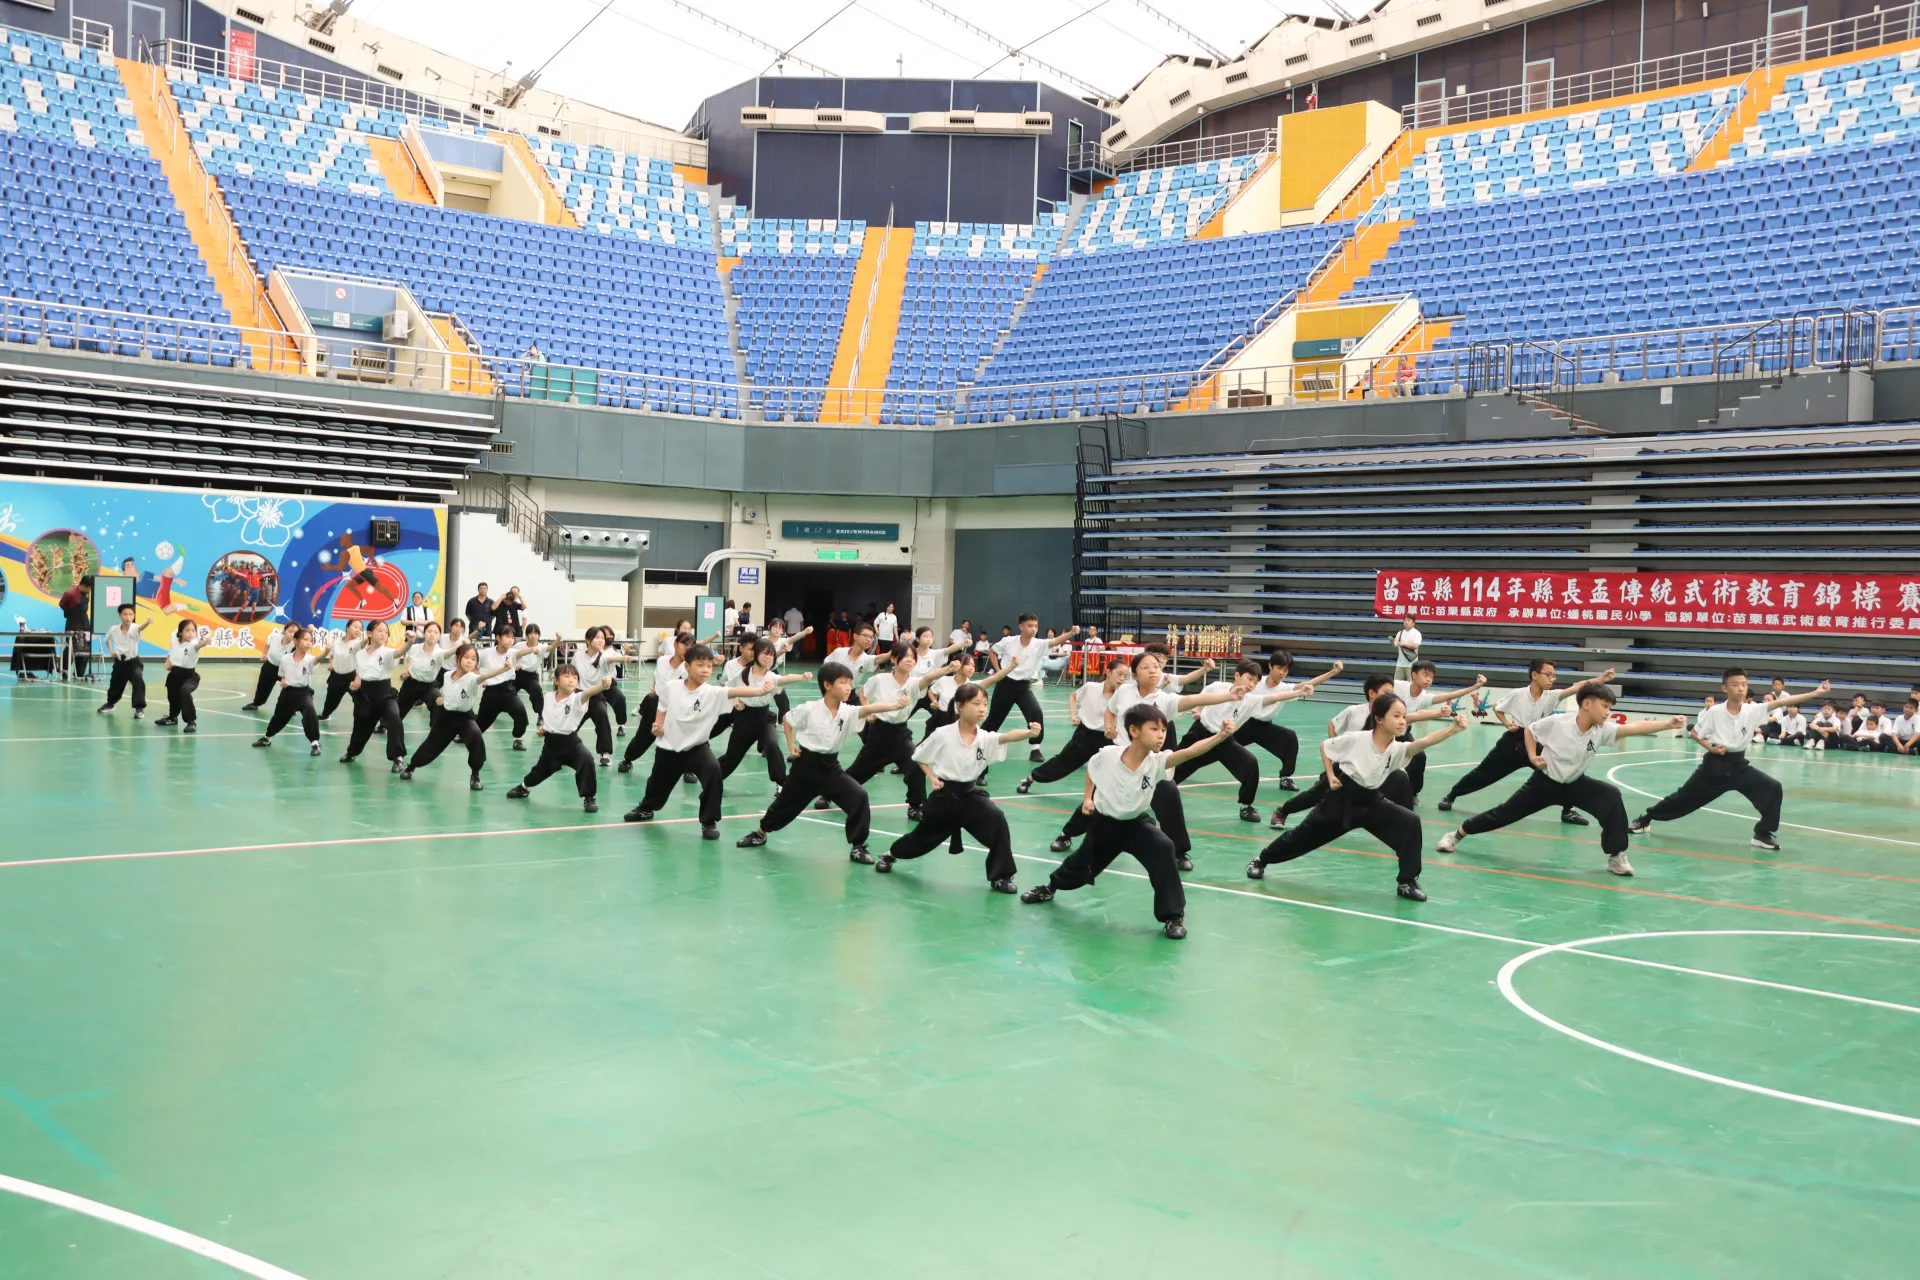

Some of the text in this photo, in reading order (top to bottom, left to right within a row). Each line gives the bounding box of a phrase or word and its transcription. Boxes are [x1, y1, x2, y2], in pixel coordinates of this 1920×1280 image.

[1382, 604, 1498, 617] 主辦單位:苗栗縣政府
